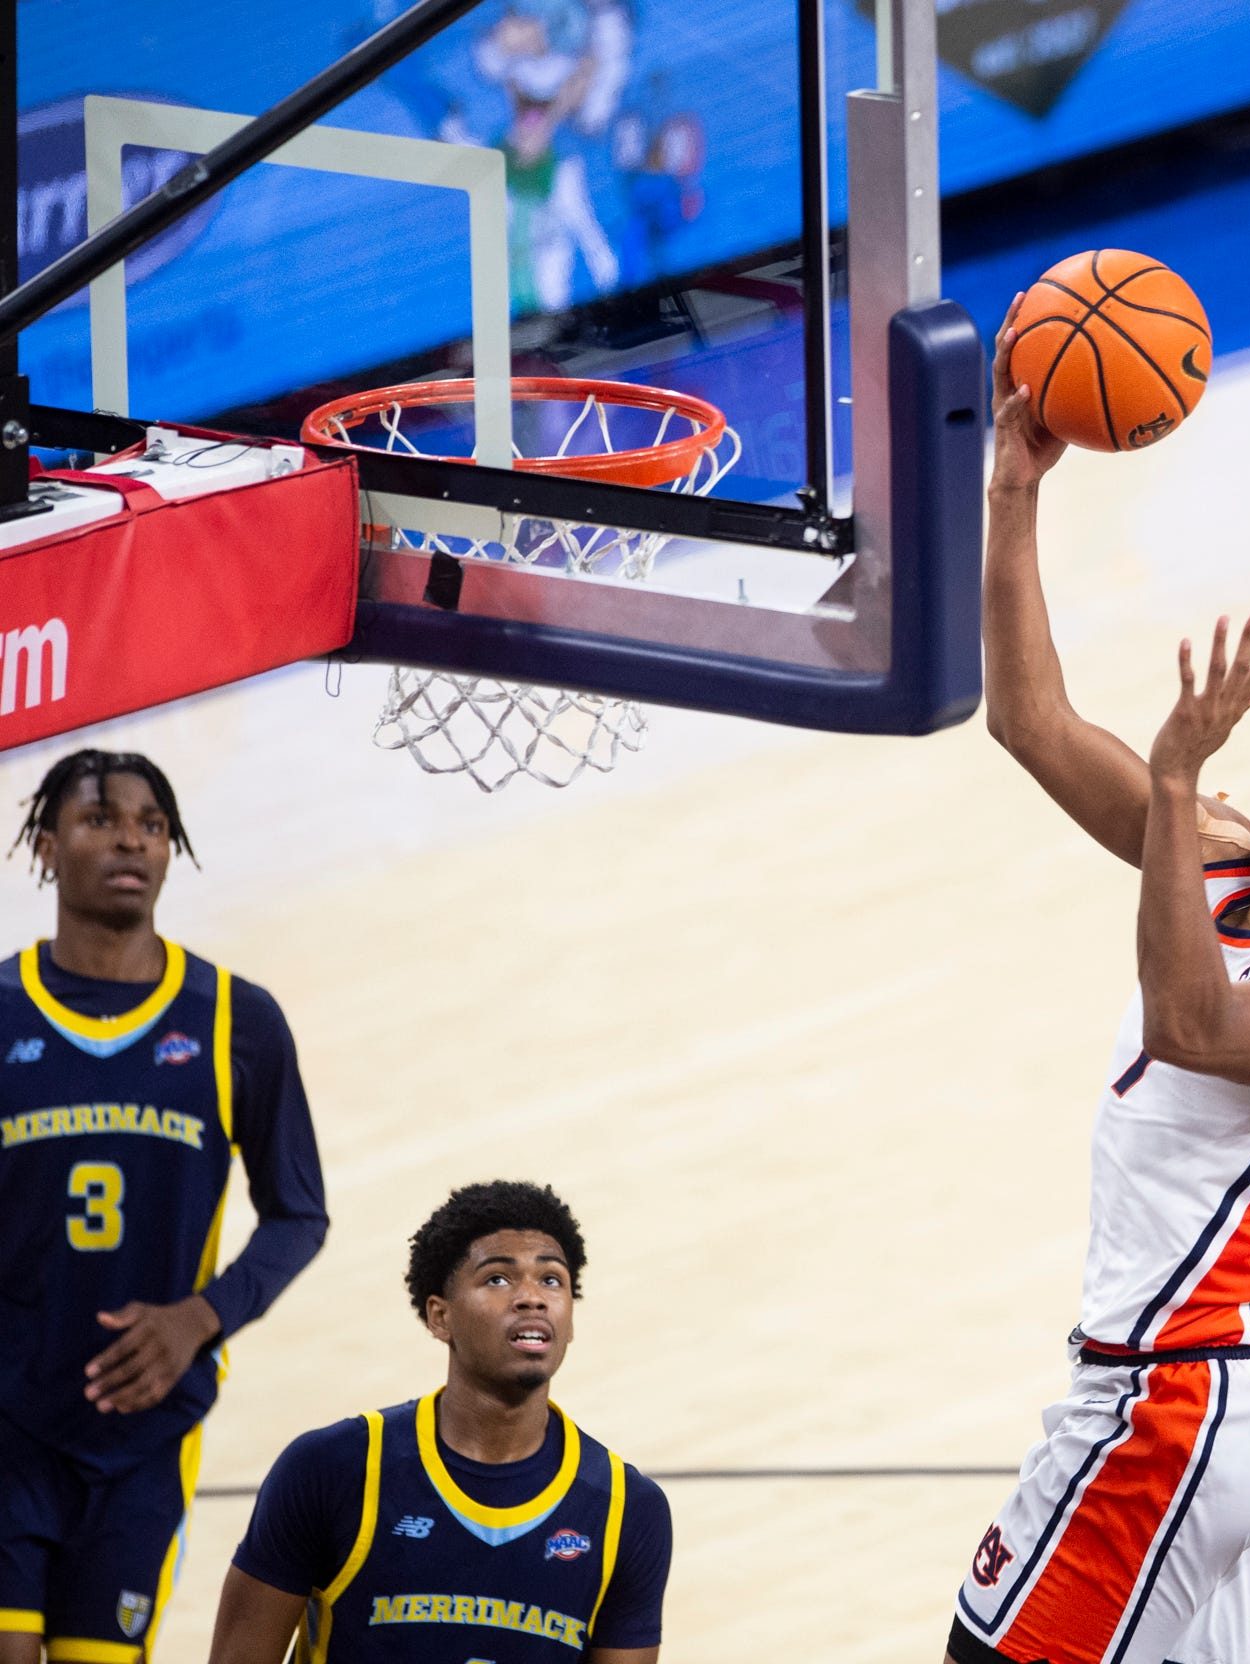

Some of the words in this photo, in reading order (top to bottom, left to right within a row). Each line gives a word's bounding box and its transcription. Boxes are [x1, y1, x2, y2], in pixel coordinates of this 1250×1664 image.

[0, 617, 69, 716] m
[0, 1103, 205, 1151] MERRIMACK
[66, 1160, 125, 1252] 3
[369, 1594, 587, 1651] MERRIMACK
